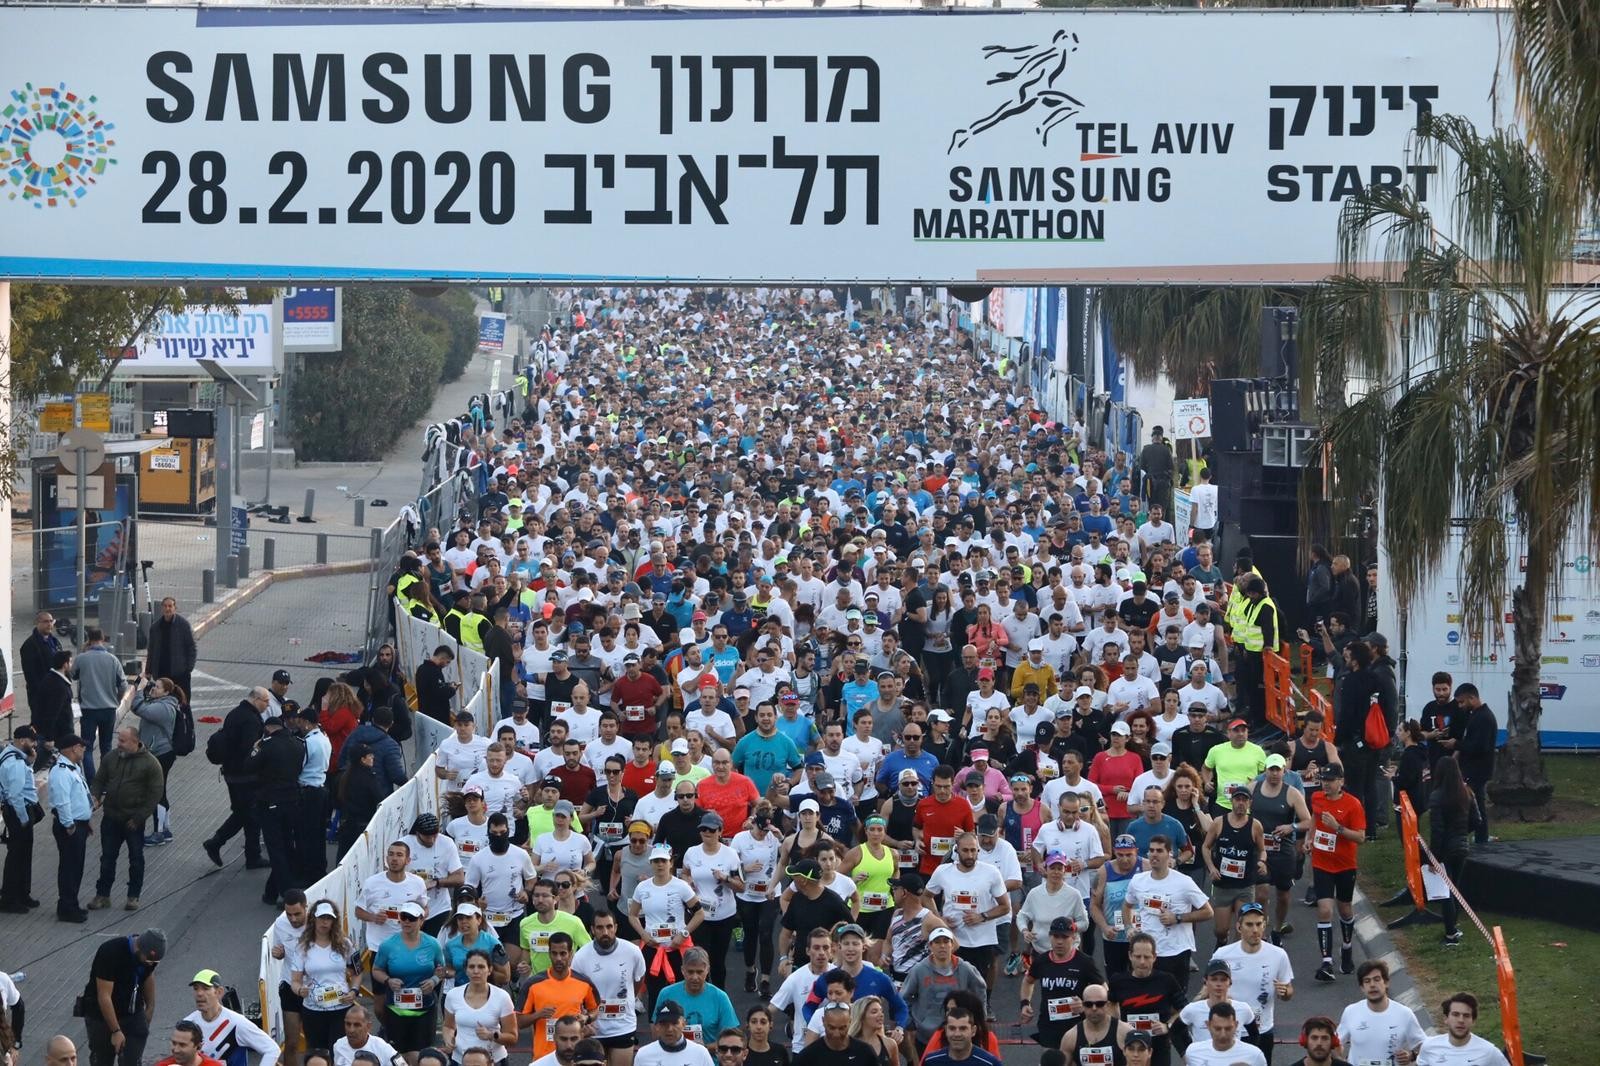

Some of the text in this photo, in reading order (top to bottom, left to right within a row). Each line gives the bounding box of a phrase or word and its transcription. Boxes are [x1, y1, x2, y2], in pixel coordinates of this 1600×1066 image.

[146, 50, 611, 124] SAMSUNG
[651, 55, 880, 135] מרתון
[1268, 85, 1439, 150] זינוק
[1075, 122, 1235, 154] TEL AVIV
[141, 150, 516, 225] 28.2.2020
[949, 165, 1171, 203] SAMSUNG
[1267, 164, 1438, 202] START
[913, 208, 1105, 239] MARATHON
[193, 313, 240, 338] פתק
[243, 313, 270, 338] רק
[156, 338, 208, 358] שינוי
[212, 338, 256, 358] יביא
[1041, 977, 1079, 991] MyWay
